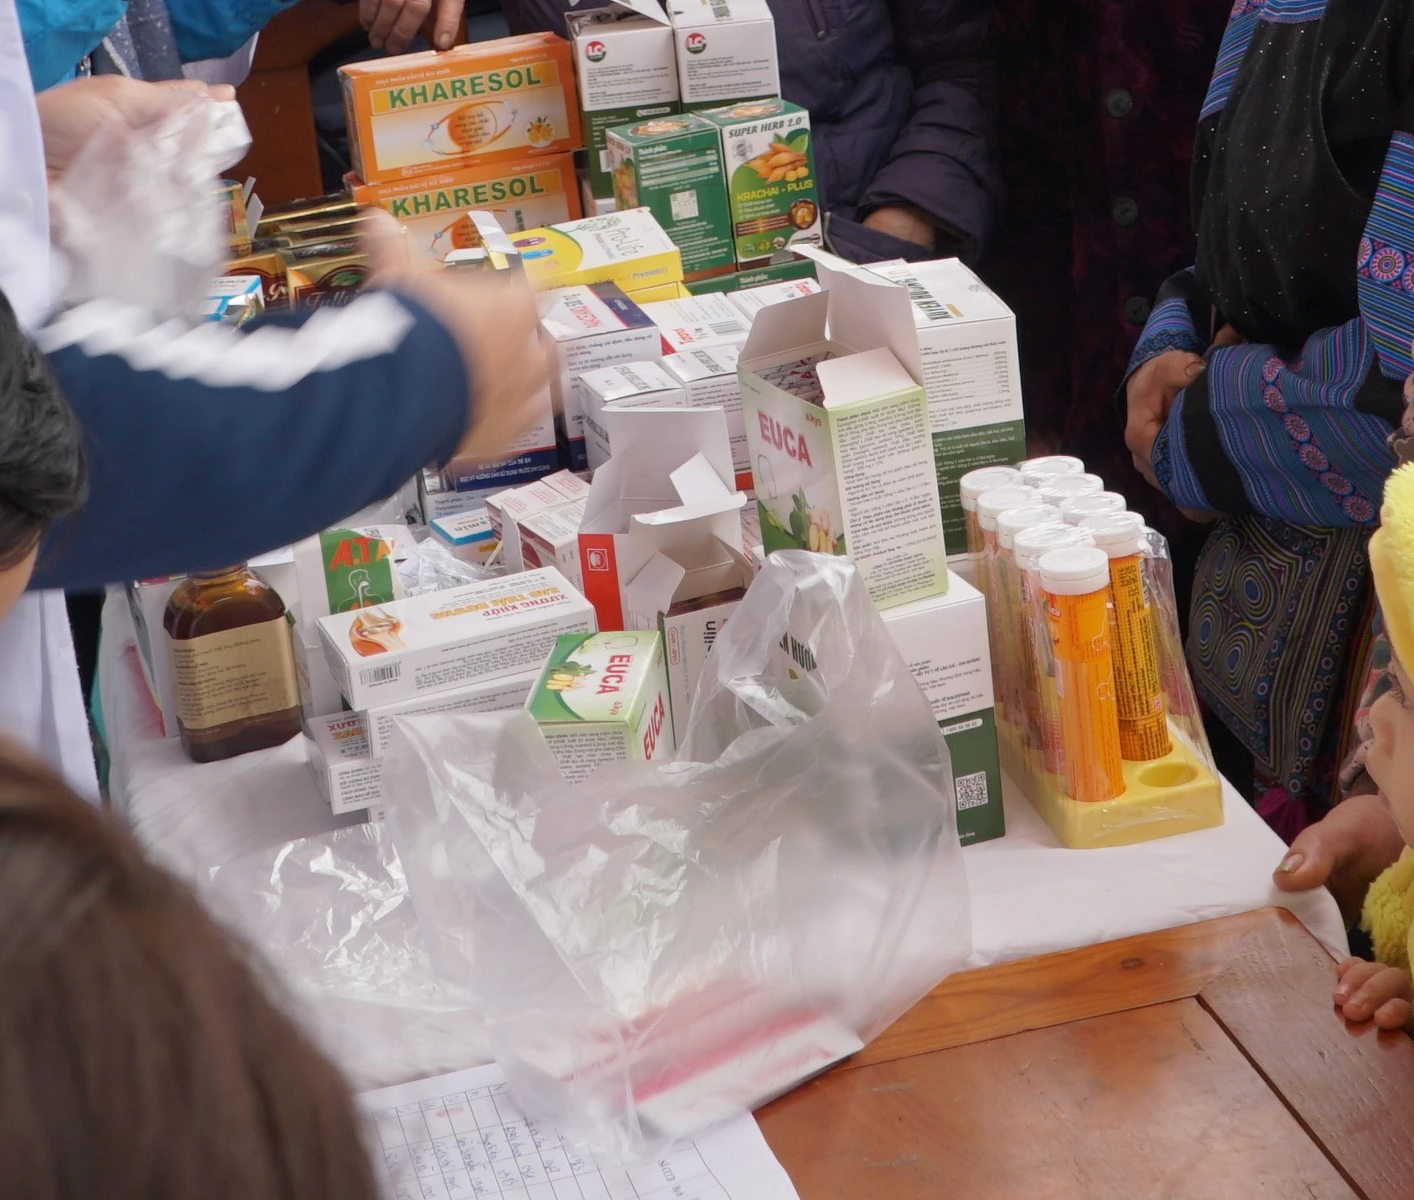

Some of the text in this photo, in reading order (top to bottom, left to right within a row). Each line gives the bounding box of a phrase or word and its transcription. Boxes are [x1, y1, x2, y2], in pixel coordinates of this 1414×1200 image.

[389, 67, 541, 109] KHARESOL
[729, 117, 802, 138] SUPER HERB 2.0
[391, 176, 544, 218] KHARESOL
[737, 180, 813, 201] KRACHAI PLUS
[757, 411, 812, 469] EUCA
[483, 594, 569, 618] XƯƠNG KHỚP
[596, 654, 631, 695] EUCA
[644, 691, 665, 760] EUCA
